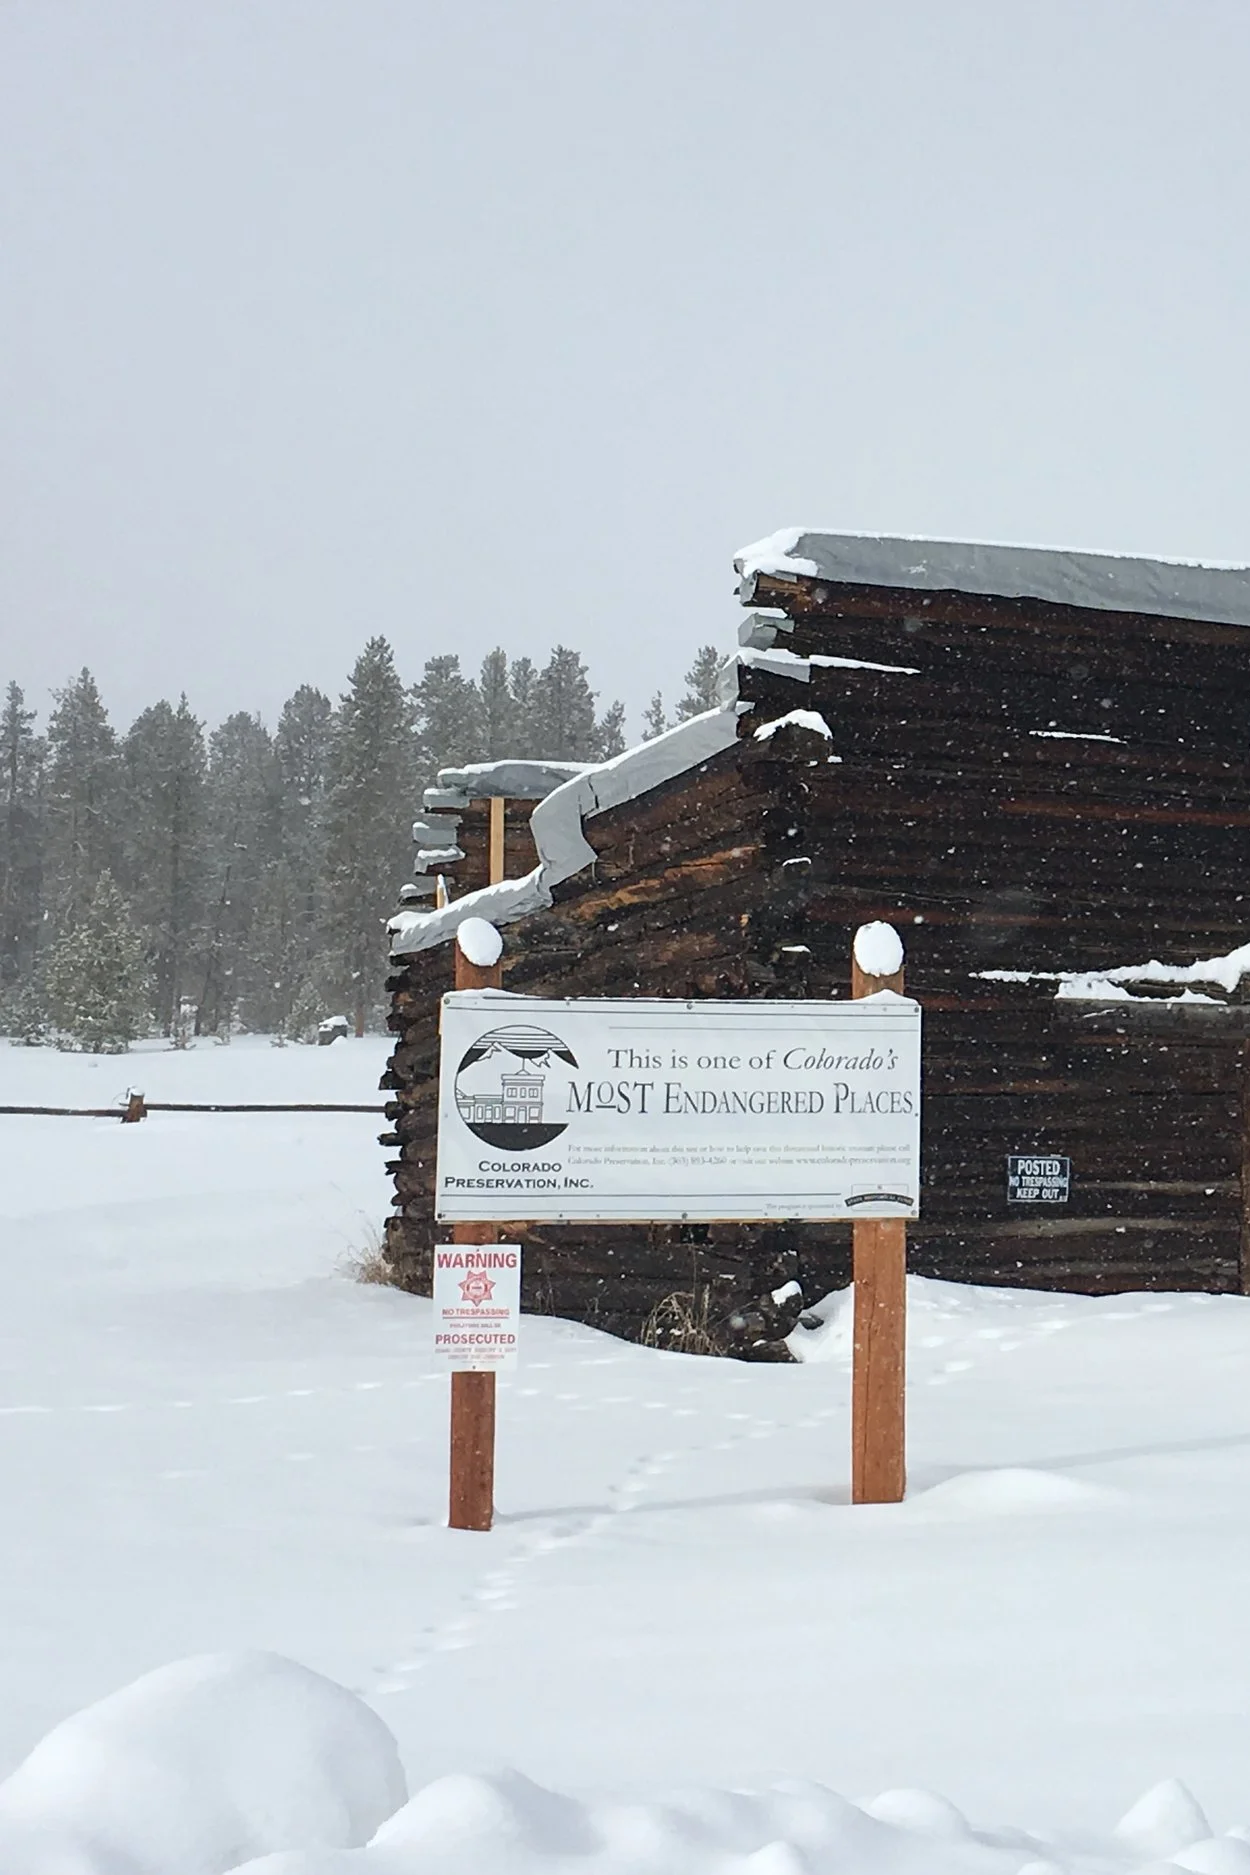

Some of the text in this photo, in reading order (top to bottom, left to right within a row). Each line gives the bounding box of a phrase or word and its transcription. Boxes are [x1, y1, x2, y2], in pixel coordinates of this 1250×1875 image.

[607, 1047, 899, 1070] This is one of Colorado's
[663, 1082, 824, 1114] ENDANGERED
[478, 1160, 562, 1173] COLORADO
[1017, 1160, 1061, 1175] POSTED
[444, 1176, 594, 1190] PRESERVATION, INC.
[1009, 1176, 1068, 1187] NO TRESPASSING
[1016, 1188, 1060, 1199] KEEP OUT
[437, 1253, 517, 1269] WARNING
[442, 1308, 510, 1316] NO TRESPASSING
[435, 1333, 516, 1345] PROSECUTED
